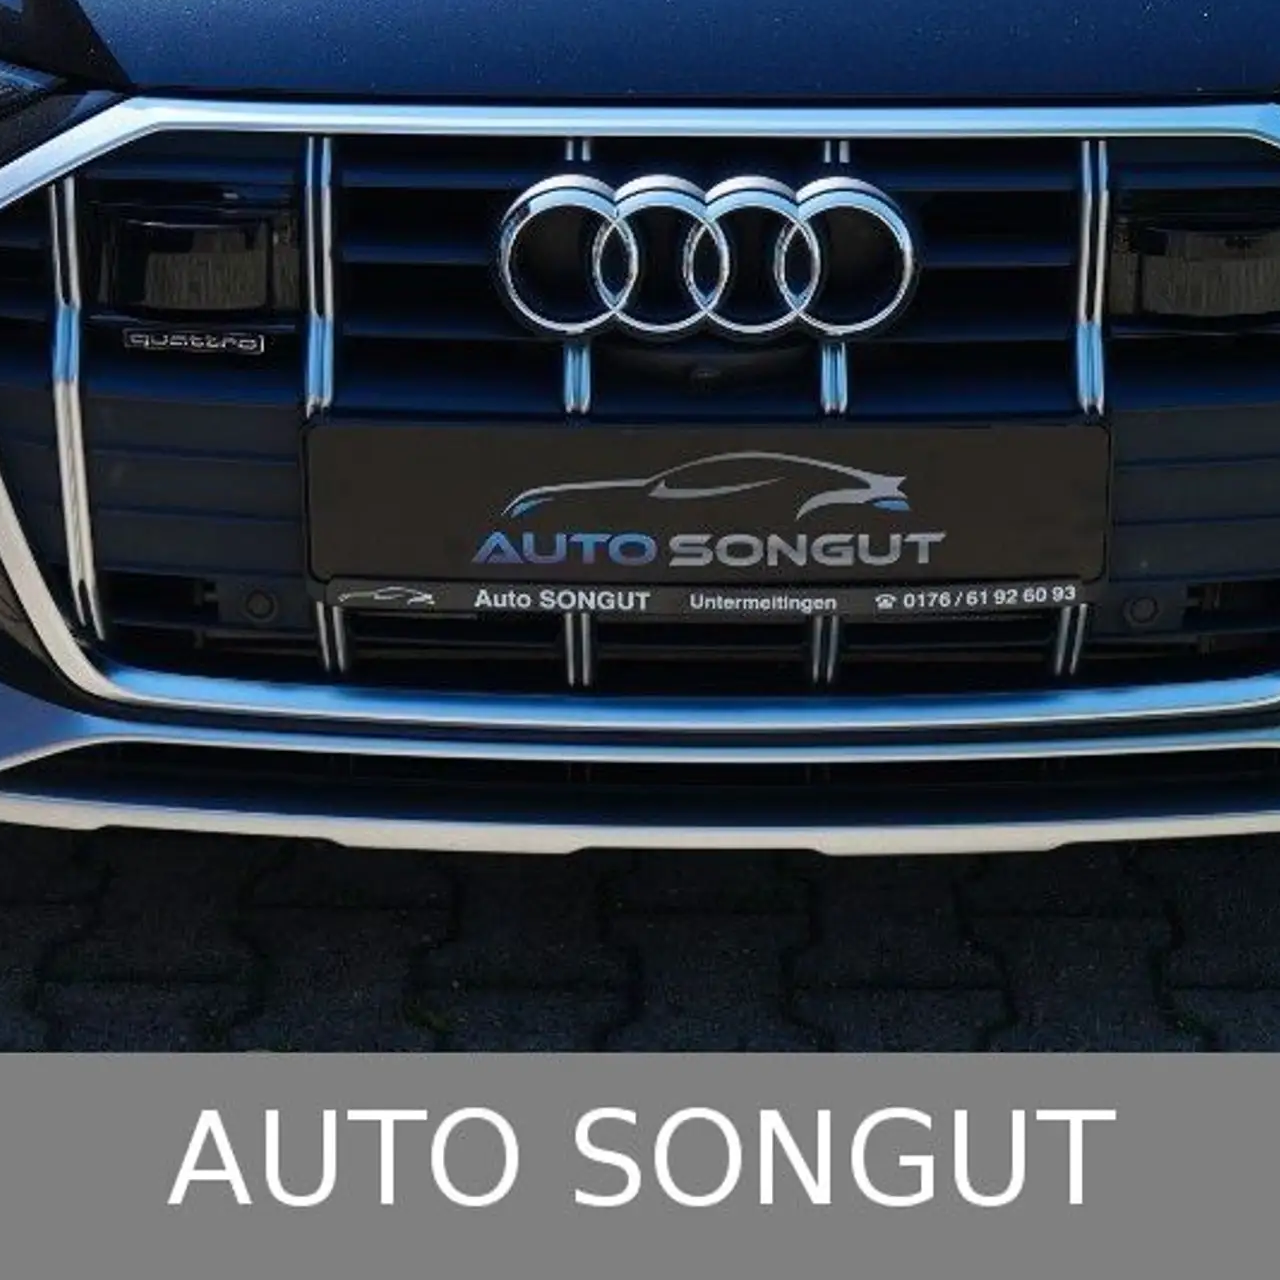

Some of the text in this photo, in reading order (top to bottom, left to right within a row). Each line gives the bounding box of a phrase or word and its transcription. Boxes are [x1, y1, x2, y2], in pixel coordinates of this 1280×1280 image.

[127, 332, 258, 351] quattro
[471, 530, 947, 567] AUTO SONGUT
[473, 588, 532, 610] Auto
[539, 588, 652, 612] SONGUT
[689, 592, 838, 615] Untermeitingen
